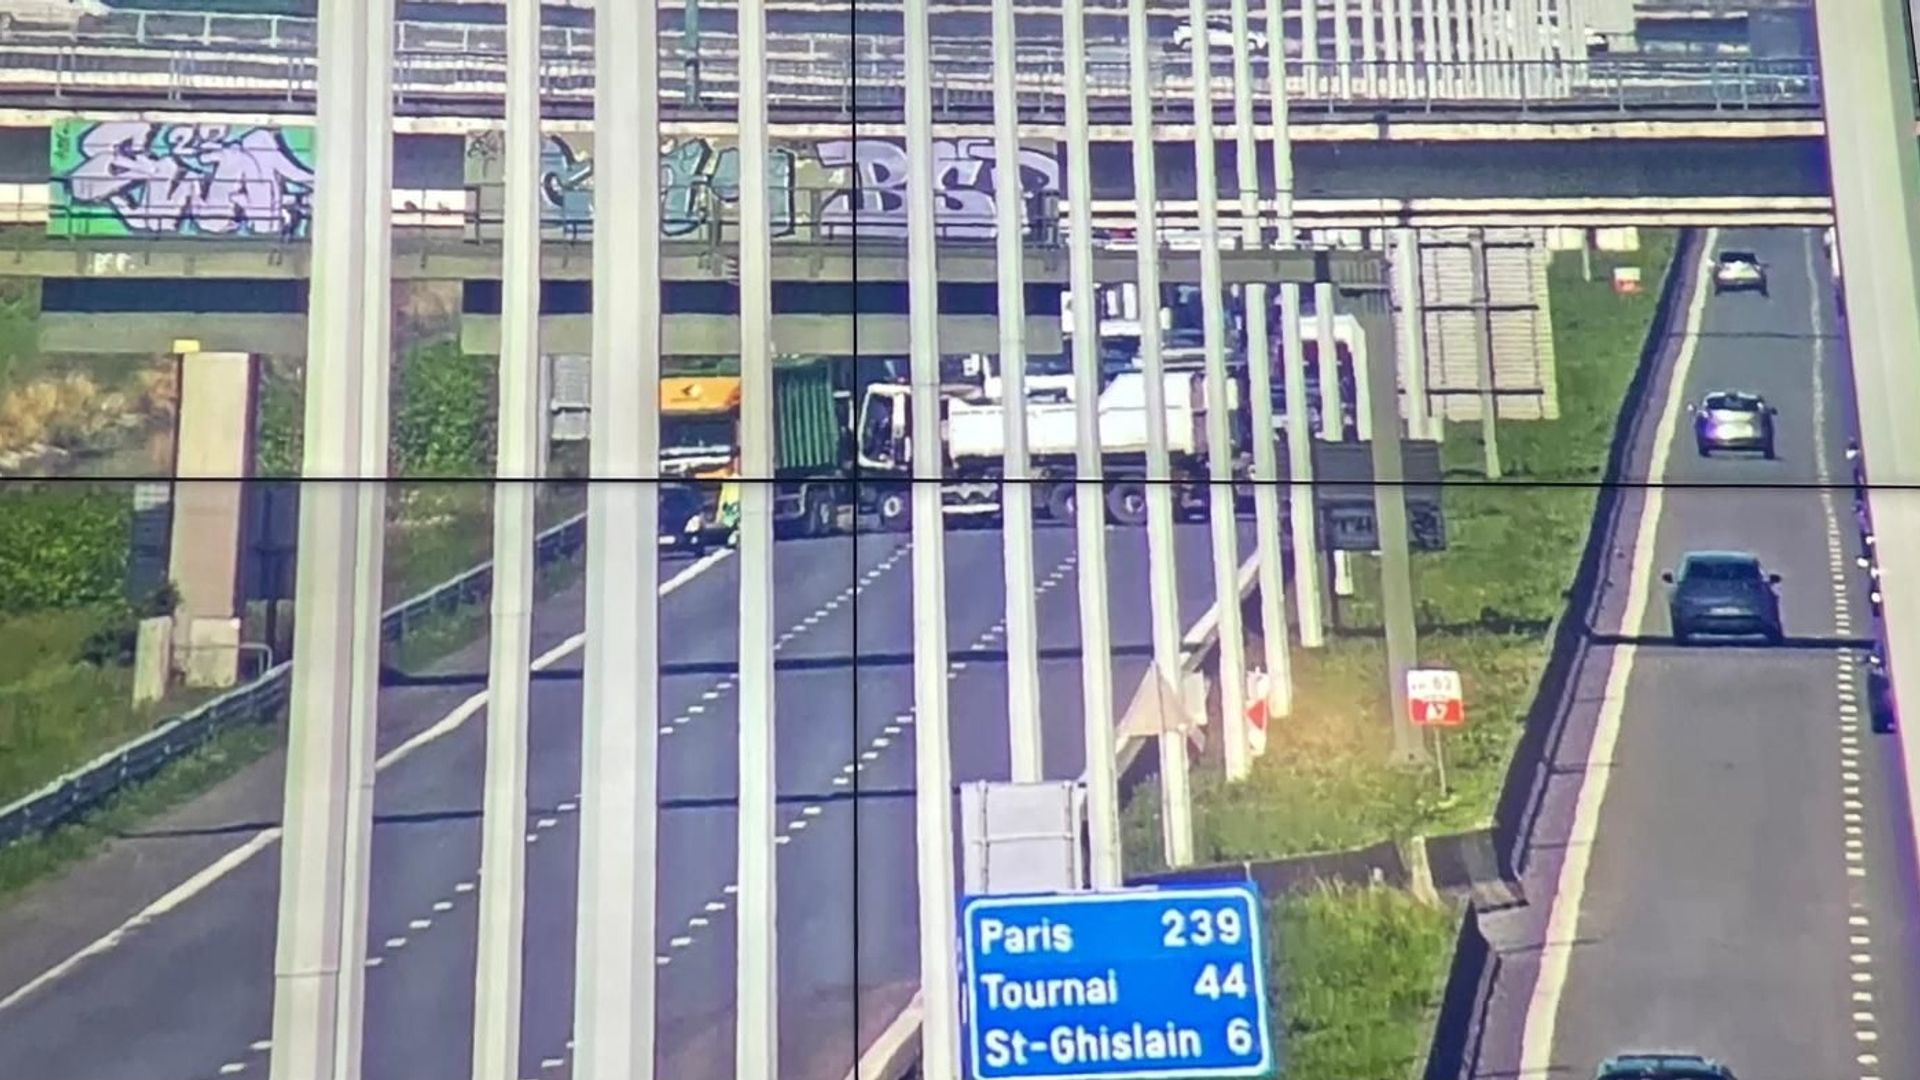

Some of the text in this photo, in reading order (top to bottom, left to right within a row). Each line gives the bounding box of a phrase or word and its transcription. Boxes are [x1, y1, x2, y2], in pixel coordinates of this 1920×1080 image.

[980, 907, 1242, 955] Paris 239
[980, 962, 1247, 1009] Tournai 44
[984, 1017, 1253, 1067] St-Ghislain 6
